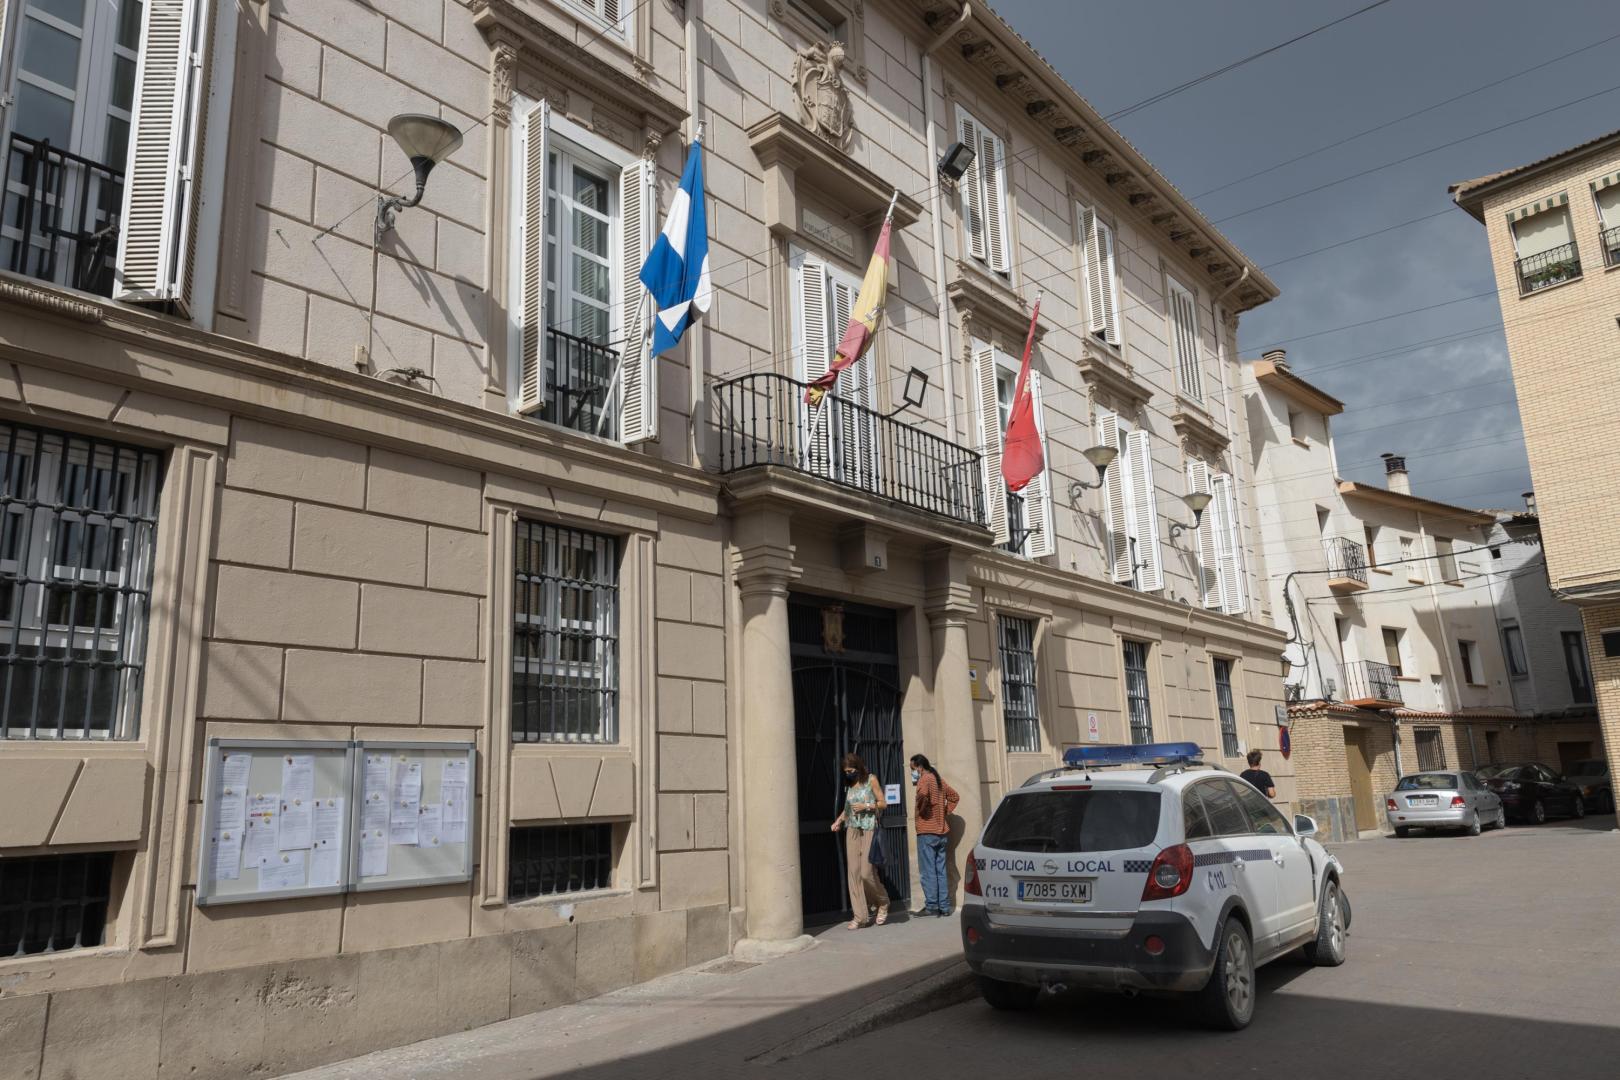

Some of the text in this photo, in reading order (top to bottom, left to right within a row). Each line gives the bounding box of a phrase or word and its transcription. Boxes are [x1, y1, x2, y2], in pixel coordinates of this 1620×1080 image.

[990, 859, 1116, 873] POLICIA LOCAL
[1213, 870, 1227, 888] 112
[992, 886, 1008, 898] 112
[1026, 883, 1087, 898] 7085 GXM
